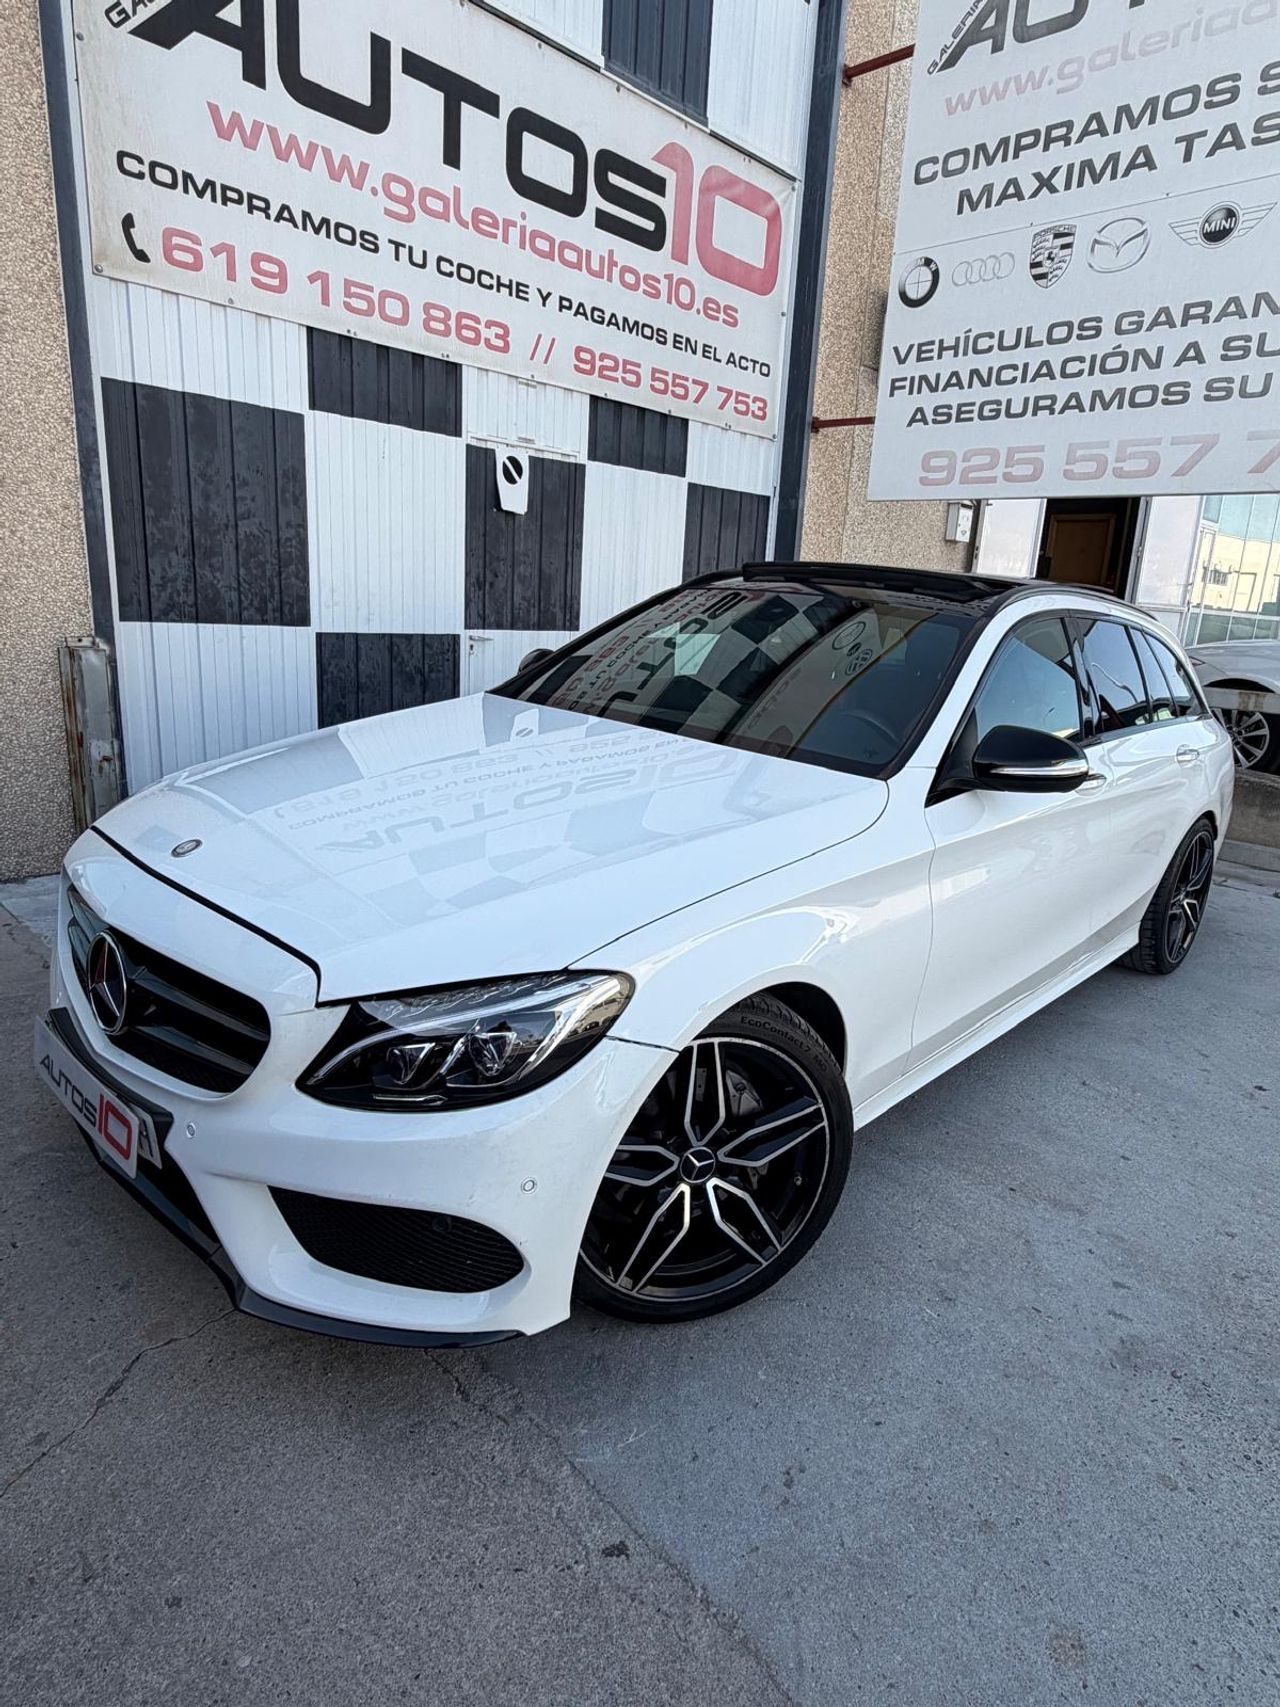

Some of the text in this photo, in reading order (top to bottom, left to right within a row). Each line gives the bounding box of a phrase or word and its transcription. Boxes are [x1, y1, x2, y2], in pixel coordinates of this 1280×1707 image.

[914, 73, 1242, 186] COMPRAMOS
[956, 112, 1280, 216] MAXIMA TAS
[206, 100, 740, 328] www.galeriaautos10.es
[1203, 217, 1236, 234] MINI
[116, 150, 771, 378] COMPRAMOS TU COCHE Y PAGAMOS EN EL ACTO
[161, 226, 289, 295] 619
[306, 270, 410, 327] 150
[422, 302, 511, 354] 863
[573, 345, 642, 389] 925
[649, 369, 709, 405] 557
[716, 386, 768, 421] 753
[892, 291, 1280, 365] VEHÍCULOS GARAN
[888, 344, 1164, 397] FINANCIACIÓN
[1172, 340, 1207, 368] A
[906, 372, 1274, 428] ASEGURAMOS SU
[918, 444, 1046, 487] 925
[1062, 433, 1220, 481] 557
[741, 1016, 804, 1050] EcoContact
[40, 1054, 133, 1161] AUTOS10
